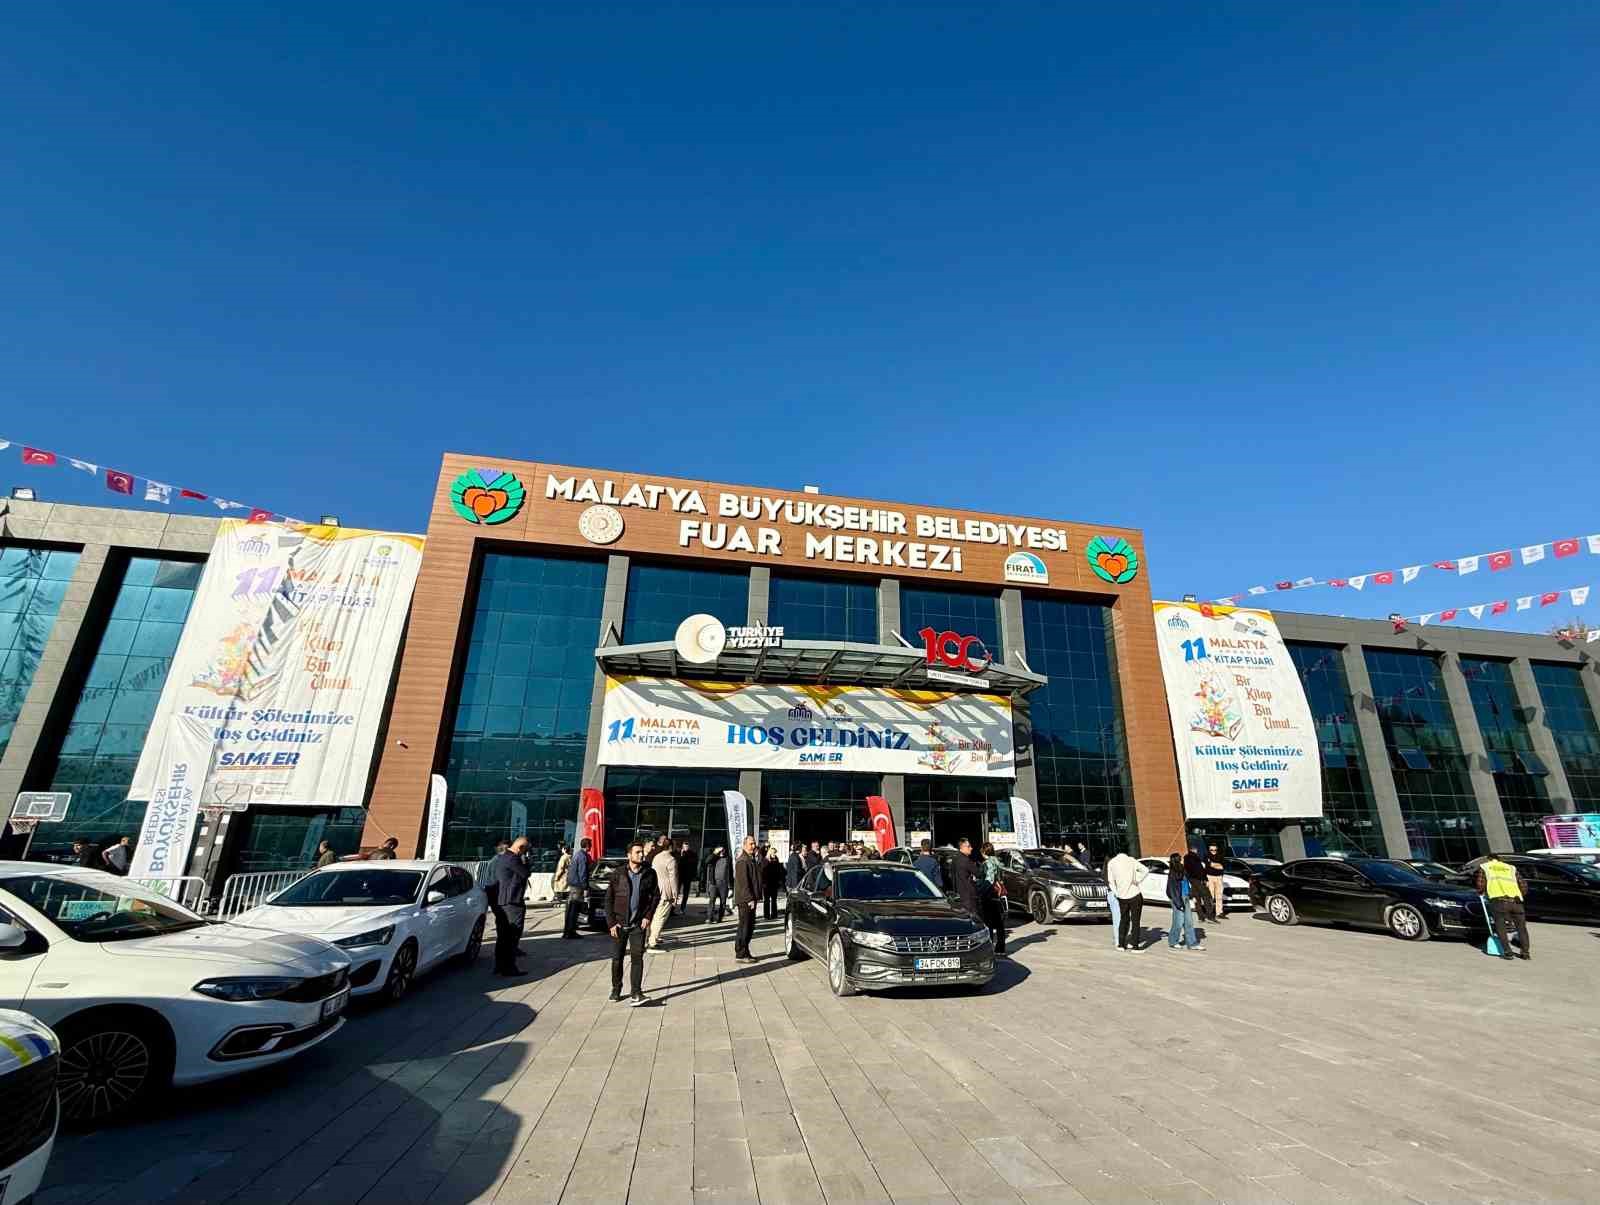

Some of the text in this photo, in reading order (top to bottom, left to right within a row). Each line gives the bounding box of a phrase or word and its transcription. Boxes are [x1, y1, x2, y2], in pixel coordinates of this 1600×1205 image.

[545, 474, 1068, 552] MALATYA BÜYÜKŞEHİR BELEDİYESİ
[679, 519, 963, 573] FUAR MERKEZİ
[1006, 563, 1035, 573] FIRAT
[918, 626, 992, 672] 100
[1209, 638, 1268, 651] MALATYA
[1236, 674, 1251, 687] Bir
[1246, 687, 1272, 703] Kitap
[250, 708, 354, 726] Şölenimize
[1254, 703, 1272, 717] Bin
[640, 718, 701, 730] MALATYA
[246, 727, 323, 745] Geldiniz
[638, 734, 700, 746] KİTAP FUARI
[727, 724, 911, 752] HOŞ GELDİNİZ
[219, 752, 300, 766] SAMİ ER
[799, 752, 843, 762] SAMİ ER
[1195, 745, 1304, 759] Kültür Şölenimize
[1215, 759, 1289, 774] Hoş Geldiniz
[1232, 777, 1280, 790] SAMİ ER
